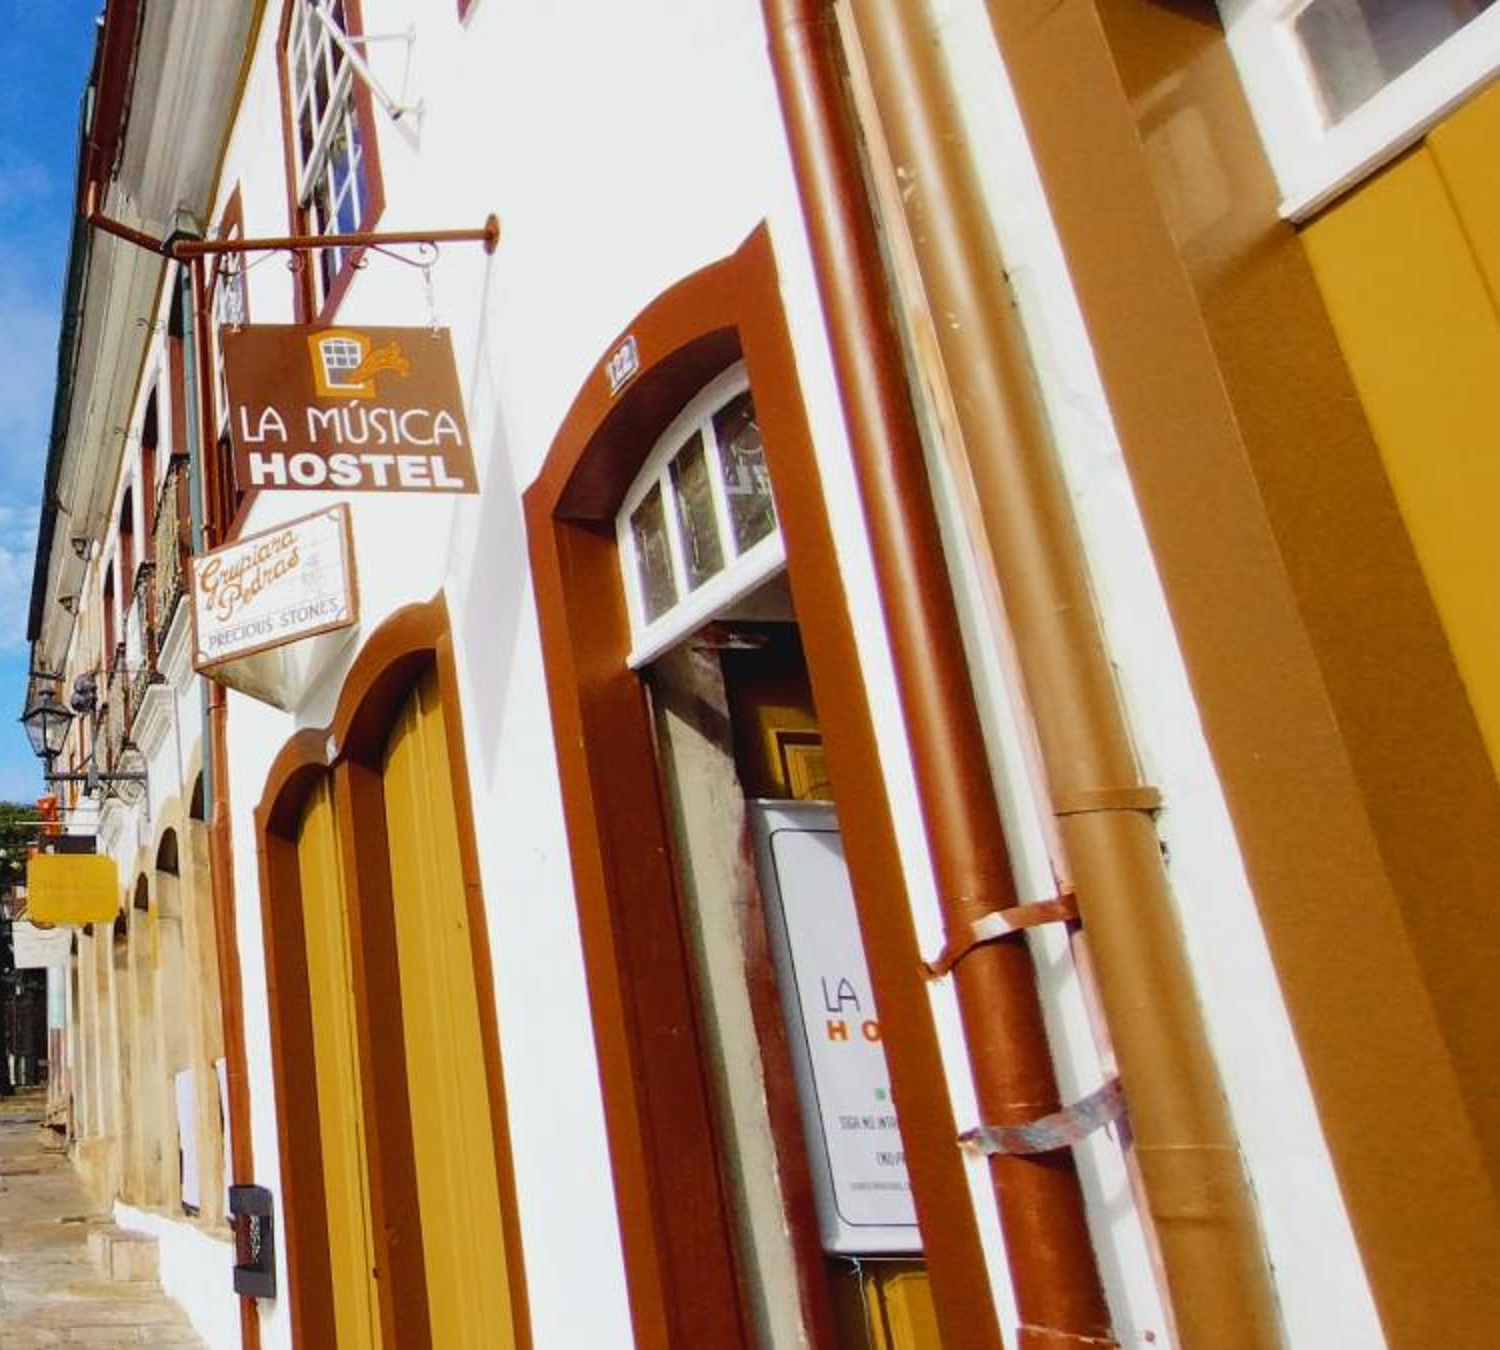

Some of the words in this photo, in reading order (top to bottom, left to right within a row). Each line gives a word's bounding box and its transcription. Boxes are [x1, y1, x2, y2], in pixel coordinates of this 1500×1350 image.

[240, 405, 287, 442] LA
[307, 399, 462, 445] MÚSICA
[250, 452, 464, 488] HOSTEL
[216, 546, 300, 622] Pedras
[208, 615, 273, 650] PRECIOUS
[279, 597, 340, 628] STONES
[821, 975, 860, 1013] LA
